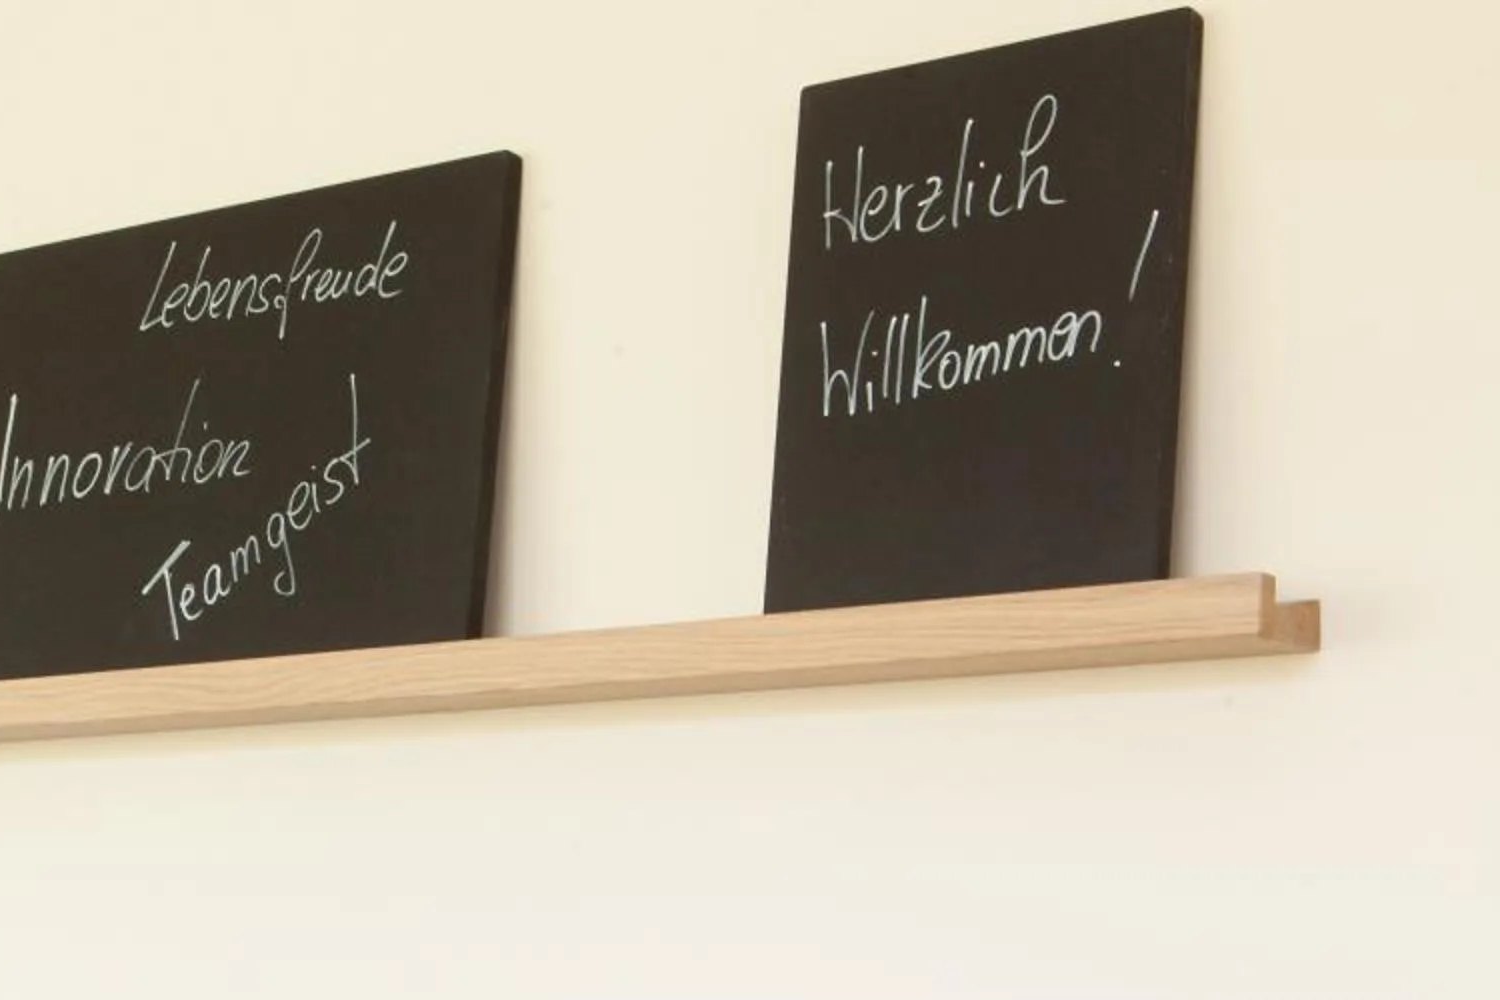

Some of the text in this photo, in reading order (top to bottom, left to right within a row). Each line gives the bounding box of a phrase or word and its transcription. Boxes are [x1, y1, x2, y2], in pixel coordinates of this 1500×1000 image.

[823, 95, 1066, 249] Herzlich
[140, 220, 408, 339] Lebensfreude
[821, 209, 1160, 417] Willkommen!
[141, 373, 371, 640] Teamgeist
